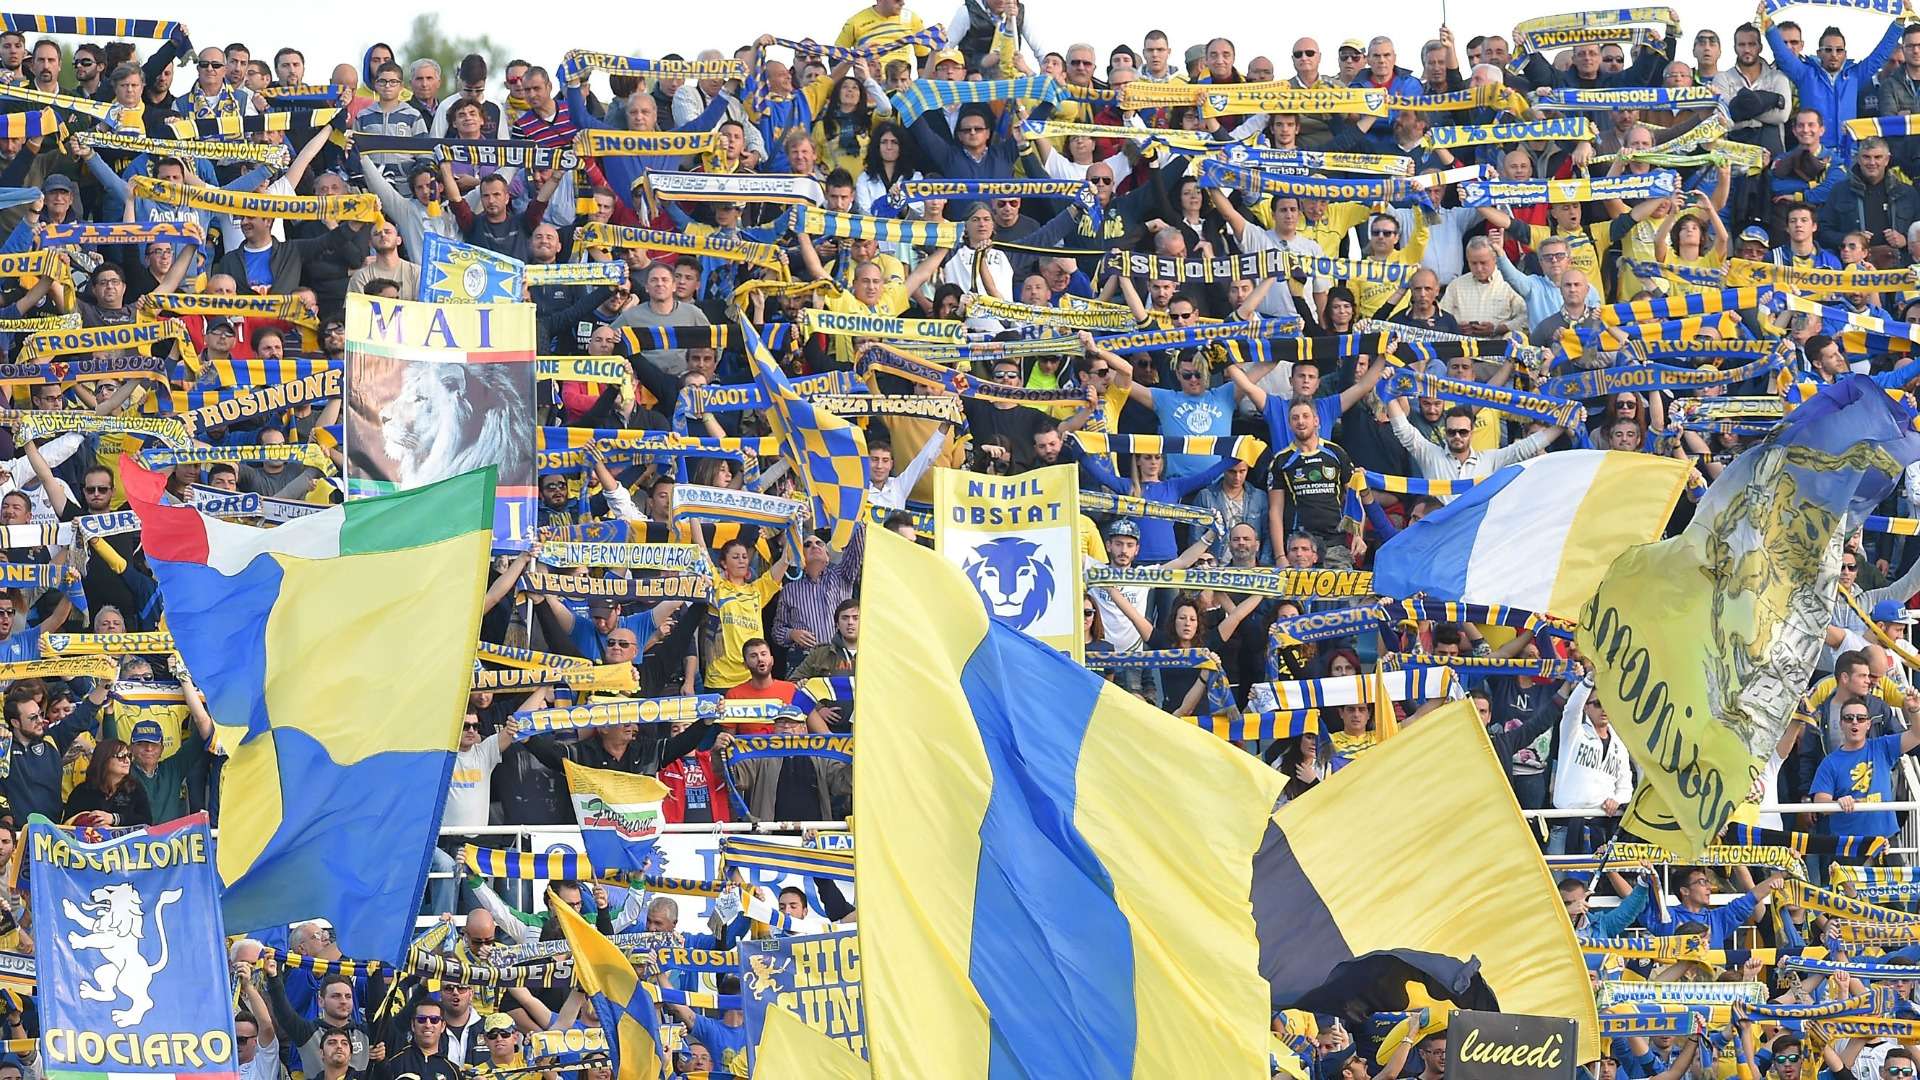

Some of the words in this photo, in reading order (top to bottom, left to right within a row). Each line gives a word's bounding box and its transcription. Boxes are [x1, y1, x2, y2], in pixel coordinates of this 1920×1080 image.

[573, 53, 629, 69] FORZA
[651, 58, 744, 74] FROSINONE
[1237, 91, 1357, 101] FROSINONE
[1259, 101, 1336, 111] CALCIO
[1576, 87, 1657, 103] FROSINONE
[1492, 116, 1585, 140] CIOCIARI
[593, 133, 714, 152] FROSINONE
[1259, 151, 1298, 160] INFERNO
[189, 188, 237, 208] 100%
[905, 182, 969, 198] FORZA
[978, 181, 1084, 197] FROSINONE
[1263, 178, 1384, 198] FROSINONE
[241, 198, 319, 215] CIOCIARI
[622, 226, 696, 248] CIOCIARI
[702, 236, 749, 254] 100%
[1131, 250, 1284, 279] HEROES
[1792, 270, 1842, 285] 100%
[153, 294, 278, 312] FROSINONE
[366, 300, 493, 349] MAI
[818, 313, 905, 335] FROSINONE
[917, 321, 964, 340] CALCIO
[35, 324, 161, 352] FROSINONE
[1097, 331, 1187, 352] CIOCIARI
[1193, 324, 1249, 344] 100%
[572, 359, 626, 377] CALCIO
[1604, 368, 1655, 389] 100%
[180, 368, 343, 434] FROSINONE
[700, 388, 749, 406] 100%
[1436, 378, 1512, 404] CIOCIARI
[1515, 395, 1561, 418] 100%
[33, 411, 86, 434] FORZA
[967, 478, 1044, 501] NIHIL
[952, 501, 1062, 525] OBSTAT
[565, 544, 627, 564] INFERNO
[631, 544, 692, 567] CIOCIARO
[528, 572, 628, 597] VECCHIO
[636, 576, 708, 600] LEONE
[1184, 568, 1279, 591] PRESENTE
[532, 696, 698, 731] FROSINONE
[32, 831, 208, 875] MASCALZONE
[1612, 843, 1671, 863] FORZA
[1707, 844, 1798, 873] FROSINONE
[1851, 926, 1914, 940] FORZA
[791, 936, 862, 988] HIC
[1823, 1021, 1912, 1035] CIOCIARI
[45, 1027, 233, 1069] CIOCIARO
[1459, 1027, 1563, 1070] lunedì
